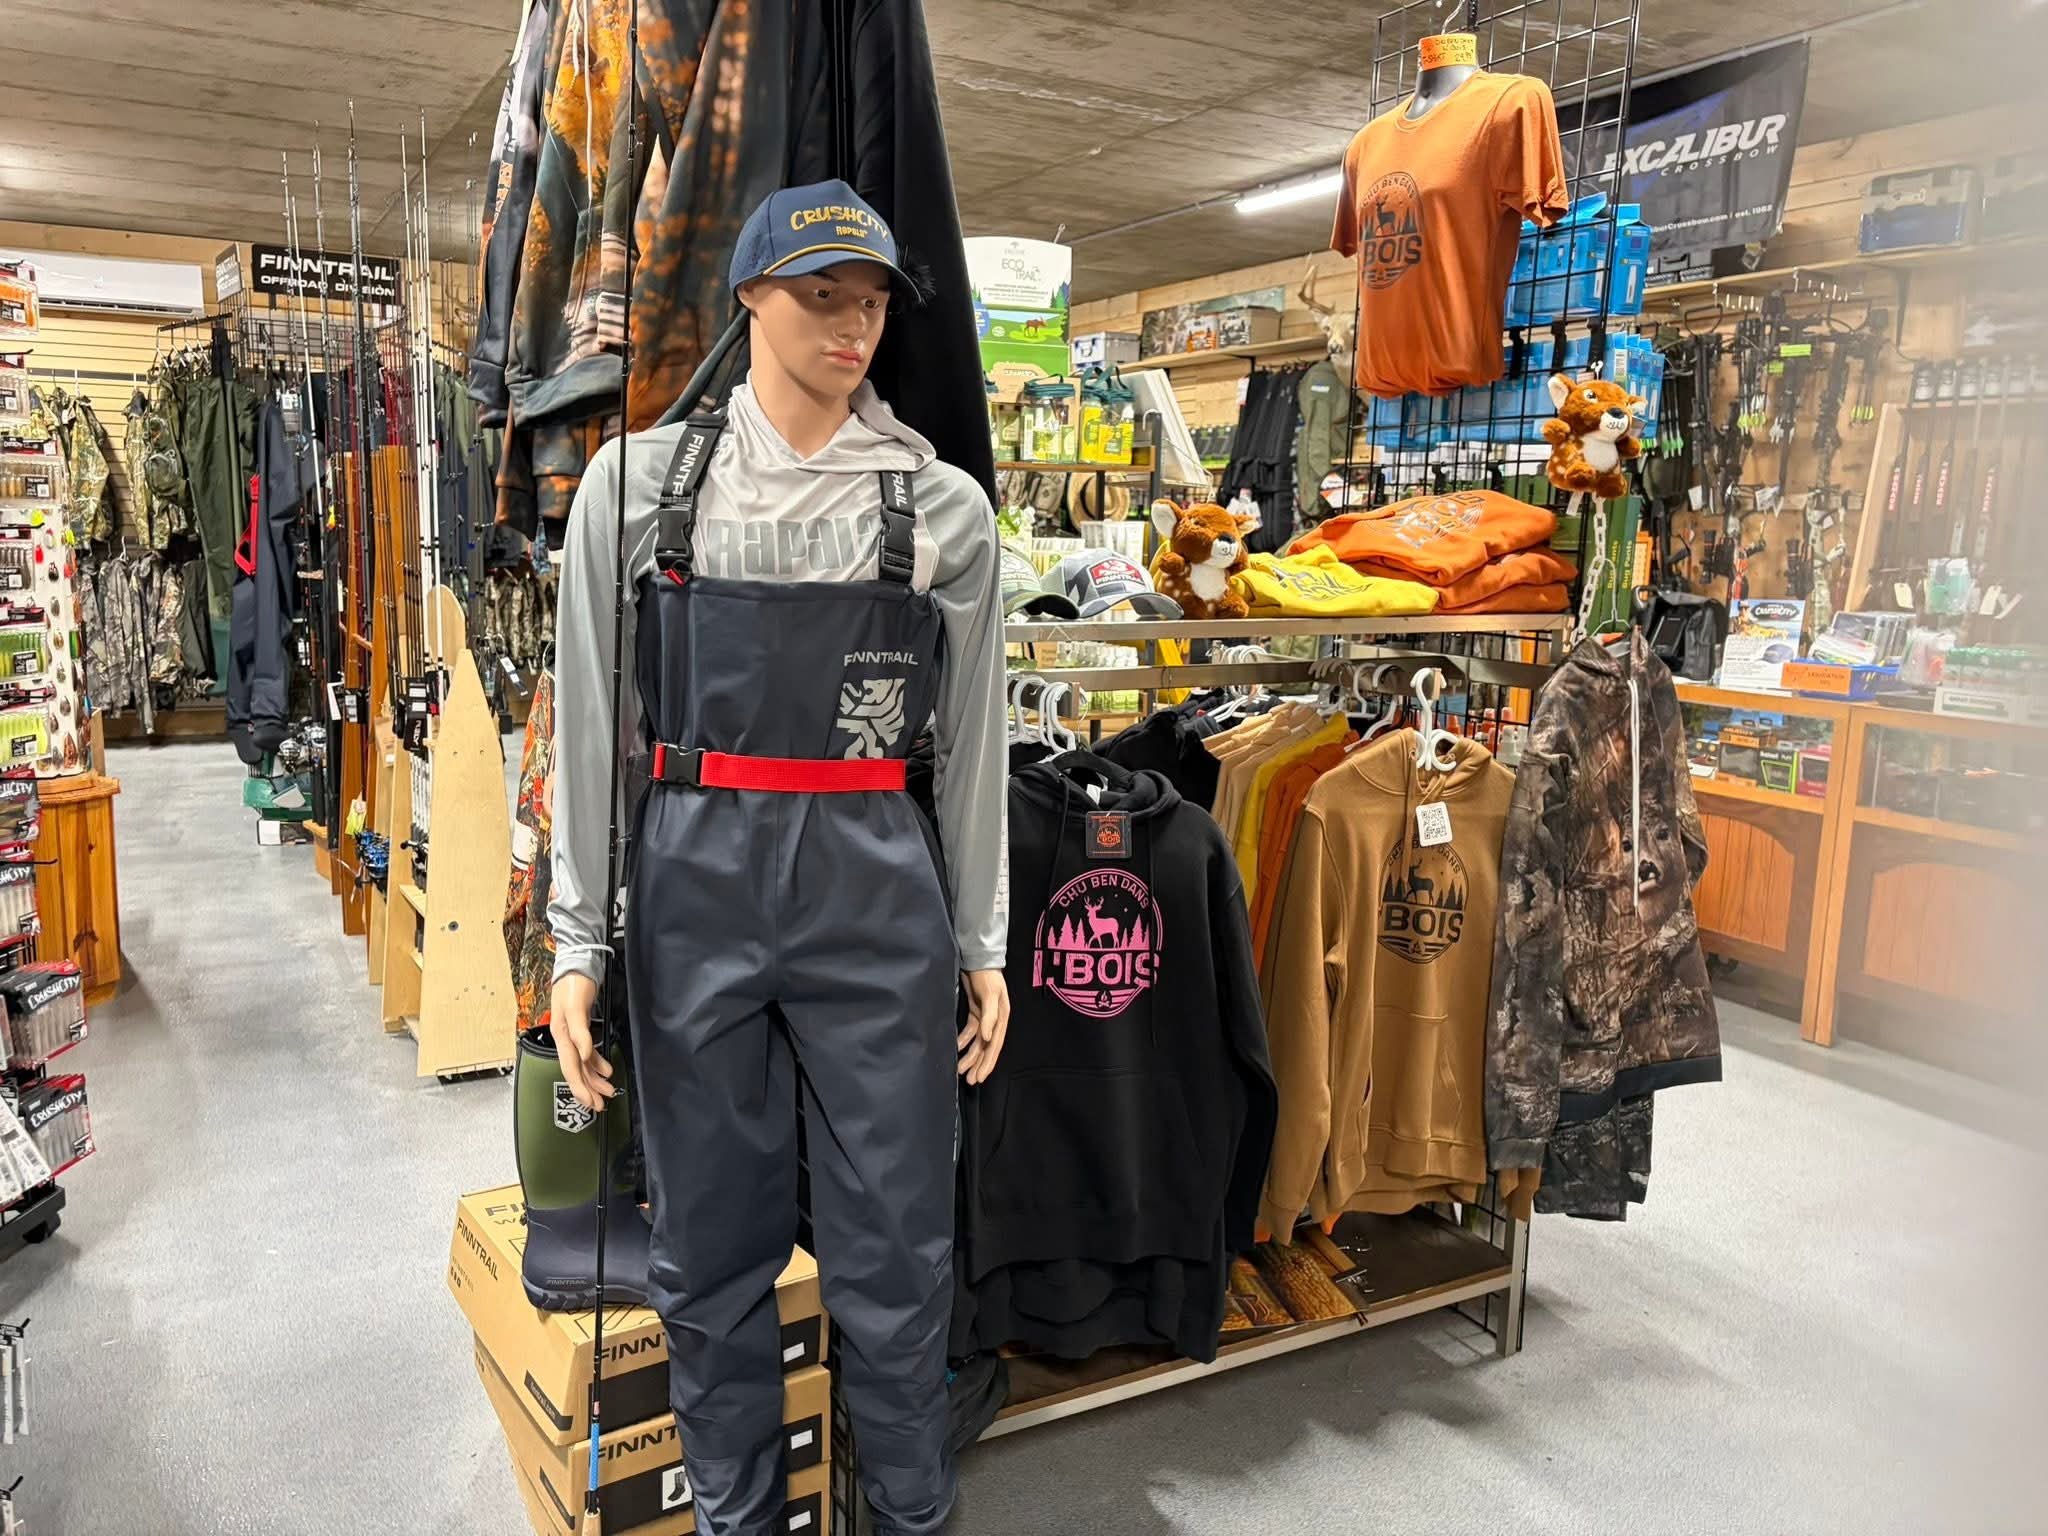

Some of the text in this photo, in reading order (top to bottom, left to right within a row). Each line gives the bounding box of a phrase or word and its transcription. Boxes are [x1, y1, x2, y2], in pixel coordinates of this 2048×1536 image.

[1599, 114, 1787, 182] EXCALIBUR
[1661, 145, 1778, 176] CROSSBOW
[790, 205, 888, 241] CRUSHCITY
[260, 253, 395, 281] FINNTRAIL
[1002, 259, 1024, 271] ECO
[261, 275, 395, 297] OFFROAD DIVSION
[1624, 540, 1633, 567] Pants
[1058, 875, 1149, 908] CHU BEN DANS
[1032, 950, 1160, 988] L'BOIS
[28, 975, 81, 1011] CRUSHCITY
[30, 1089, 83, 1128] CRUSHCITY
[457, 1217, 499, 1281] FINNTRAIL
[599, 1332, 668, 1363] FINN
